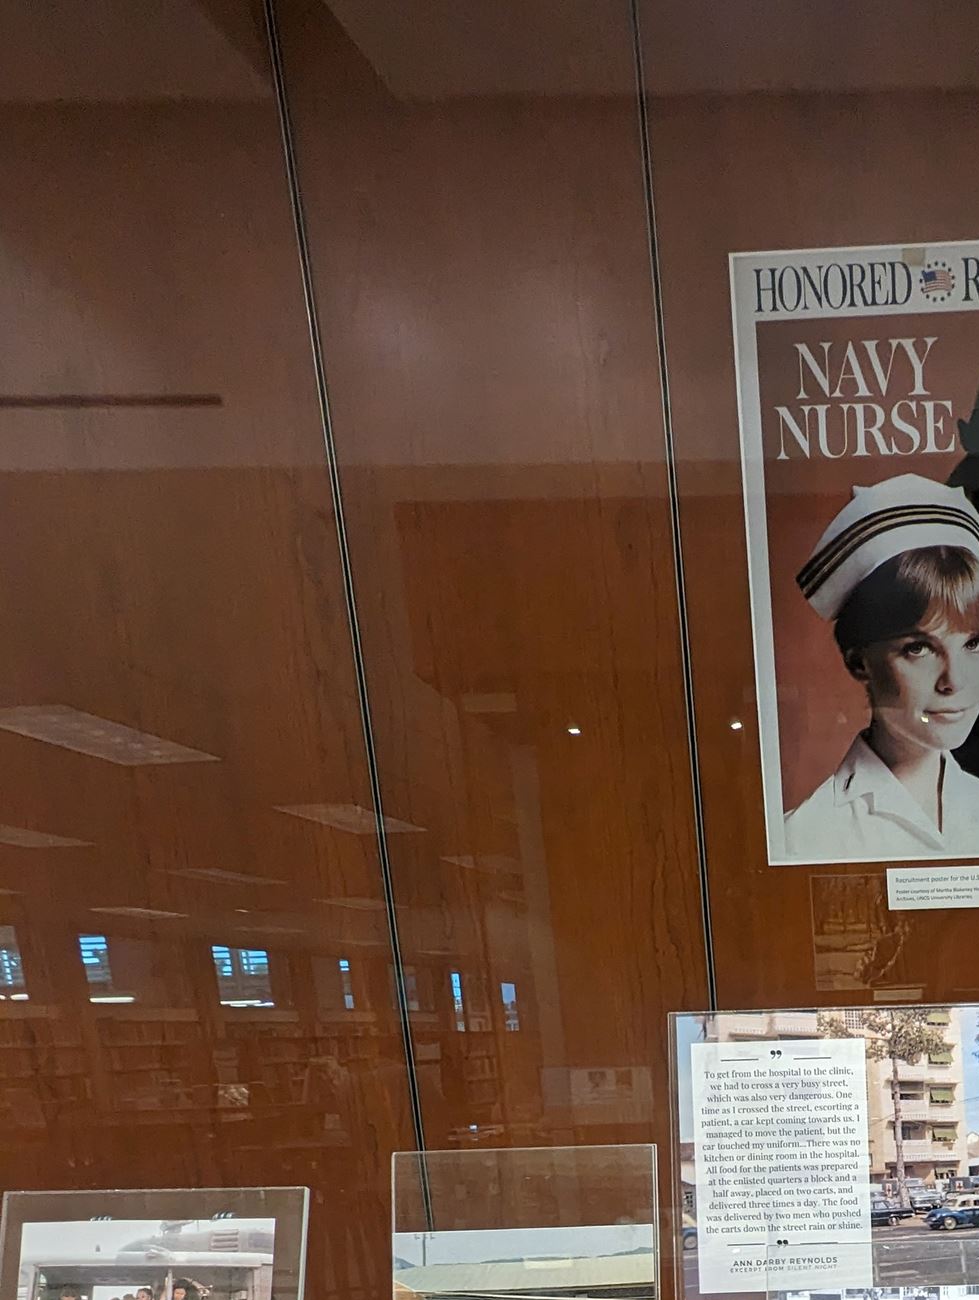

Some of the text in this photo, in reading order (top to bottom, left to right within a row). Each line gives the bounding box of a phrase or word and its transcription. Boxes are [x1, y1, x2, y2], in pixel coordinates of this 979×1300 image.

[753, 261, 912, 313] HONORED
[793, 336, 938, 400] NAVY
[774, 400, 956, 460] NURSE
[703, 1070, 715, 1079] To
[716, 1071, 729, 1079] get
[731, 1069, 751, 1078] from
[753, 1069, 766, 1077] the
[768, 1067, 801, 1078] hospital
[803, 1068, 811, 1076] to
[813, 1067, 826, 1075] the
[723, 1081, 739, 1090] had
[781, 1081, 799, 1089] very
[800, 1079, 820, 1089] busy
[755, 1258, 786, 1266] DARBY
[789, 1256, 837, 1264] REYNOLDS
